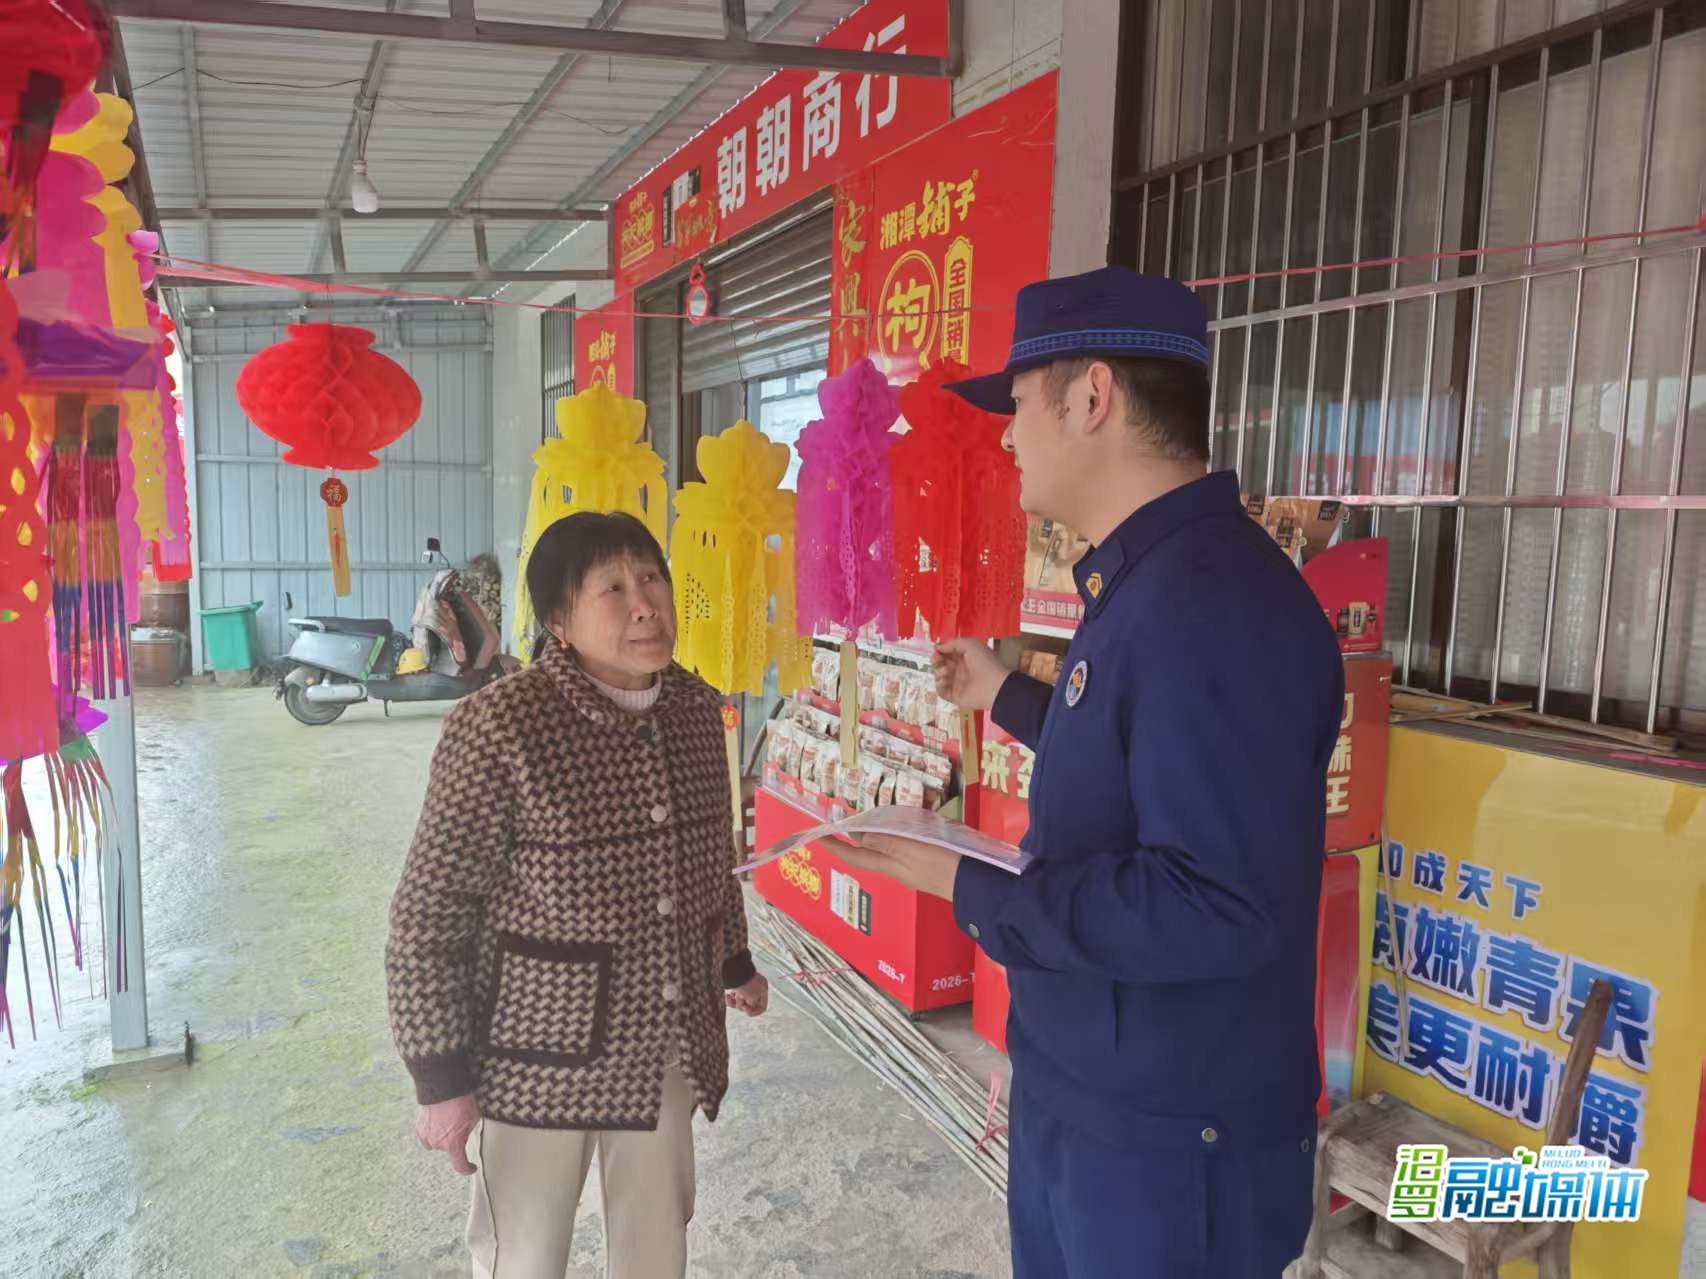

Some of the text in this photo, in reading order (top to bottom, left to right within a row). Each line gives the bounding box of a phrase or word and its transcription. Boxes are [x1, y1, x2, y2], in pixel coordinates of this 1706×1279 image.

[717, 14, 906, 219] 朝朝商行
[880, 179, 976, 250] 湘潭铺子
